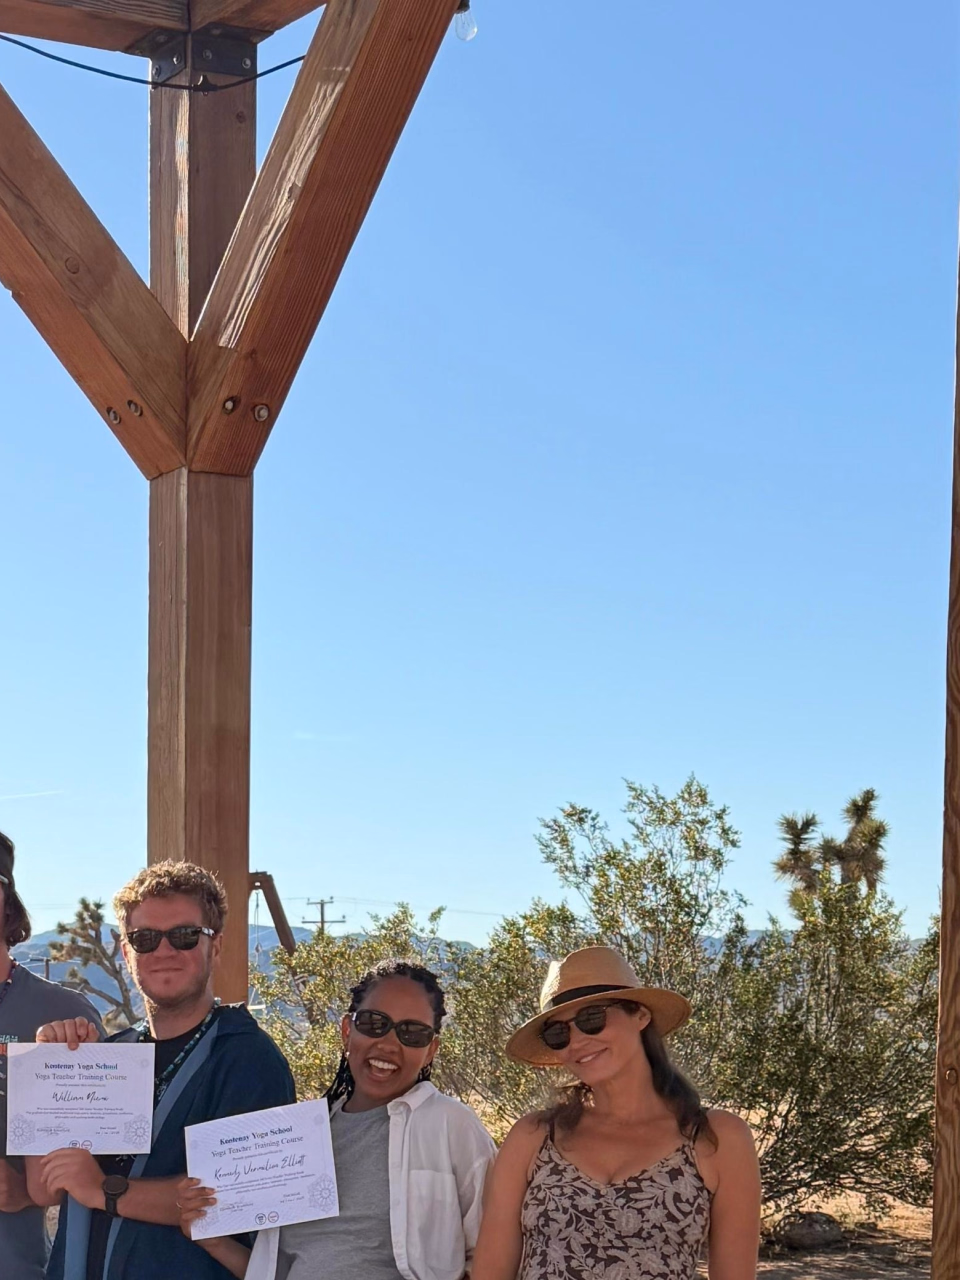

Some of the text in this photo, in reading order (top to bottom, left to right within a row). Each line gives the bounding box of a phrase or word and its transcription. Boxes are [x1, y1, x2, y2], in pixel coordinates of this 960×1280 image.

[45, 1063, 75, 1071] Kootenay
[52, 1091, 84, 1102] William
[220, 1126, 292, 1145] Kootenay Yoga School
[228, 1145, 252, 1154] Teacher
[254, 1140, 279, 1149] Training
[281, 1136, 303, 1145] Course
